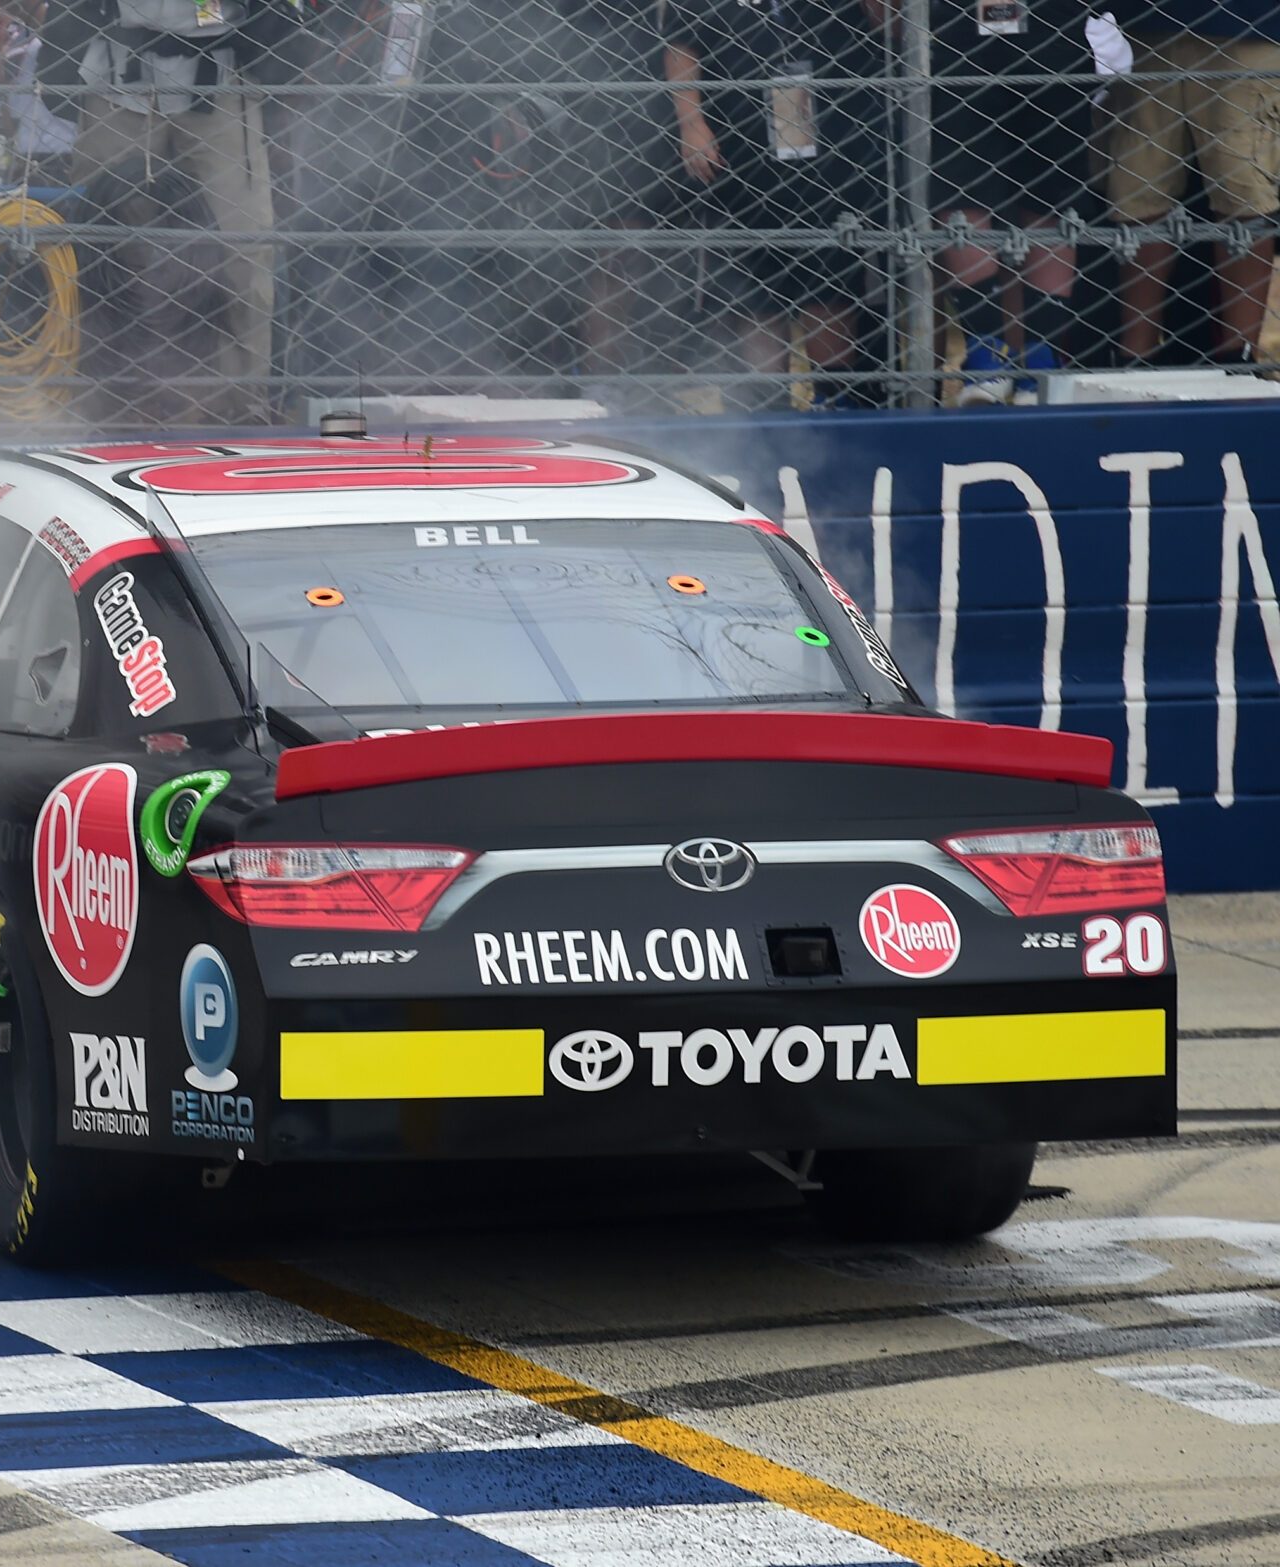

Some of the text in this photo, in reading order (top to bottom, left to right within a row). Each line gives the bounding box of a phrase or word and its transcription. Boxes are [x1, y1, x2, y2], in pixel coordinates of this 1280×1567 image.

[414, 523, 540, 548] BELL
[94, 571, 176, 717] GameStop
[47, 767, 132, 953] Rheem
[144, 840, 187, 874] ETHANOL
[867, 888, 956, 963] Rheem
[1021, 931, 1078, 949] XSE
[1082, 912, 1167, 977] 20
[289, 948, 420, 968] CAMRY
[473, 928, 750, 986] RHEEM.COM
[69, 1031, 149, 1112] P&N
[638, 1023, 912, 1087] TOYOTA
[71, 1108, 150, 1138] DISTRIBUTION
[171, 1089, 255, 1126] PENCO
[171, 1122, 256, 1144] CORPORATION
